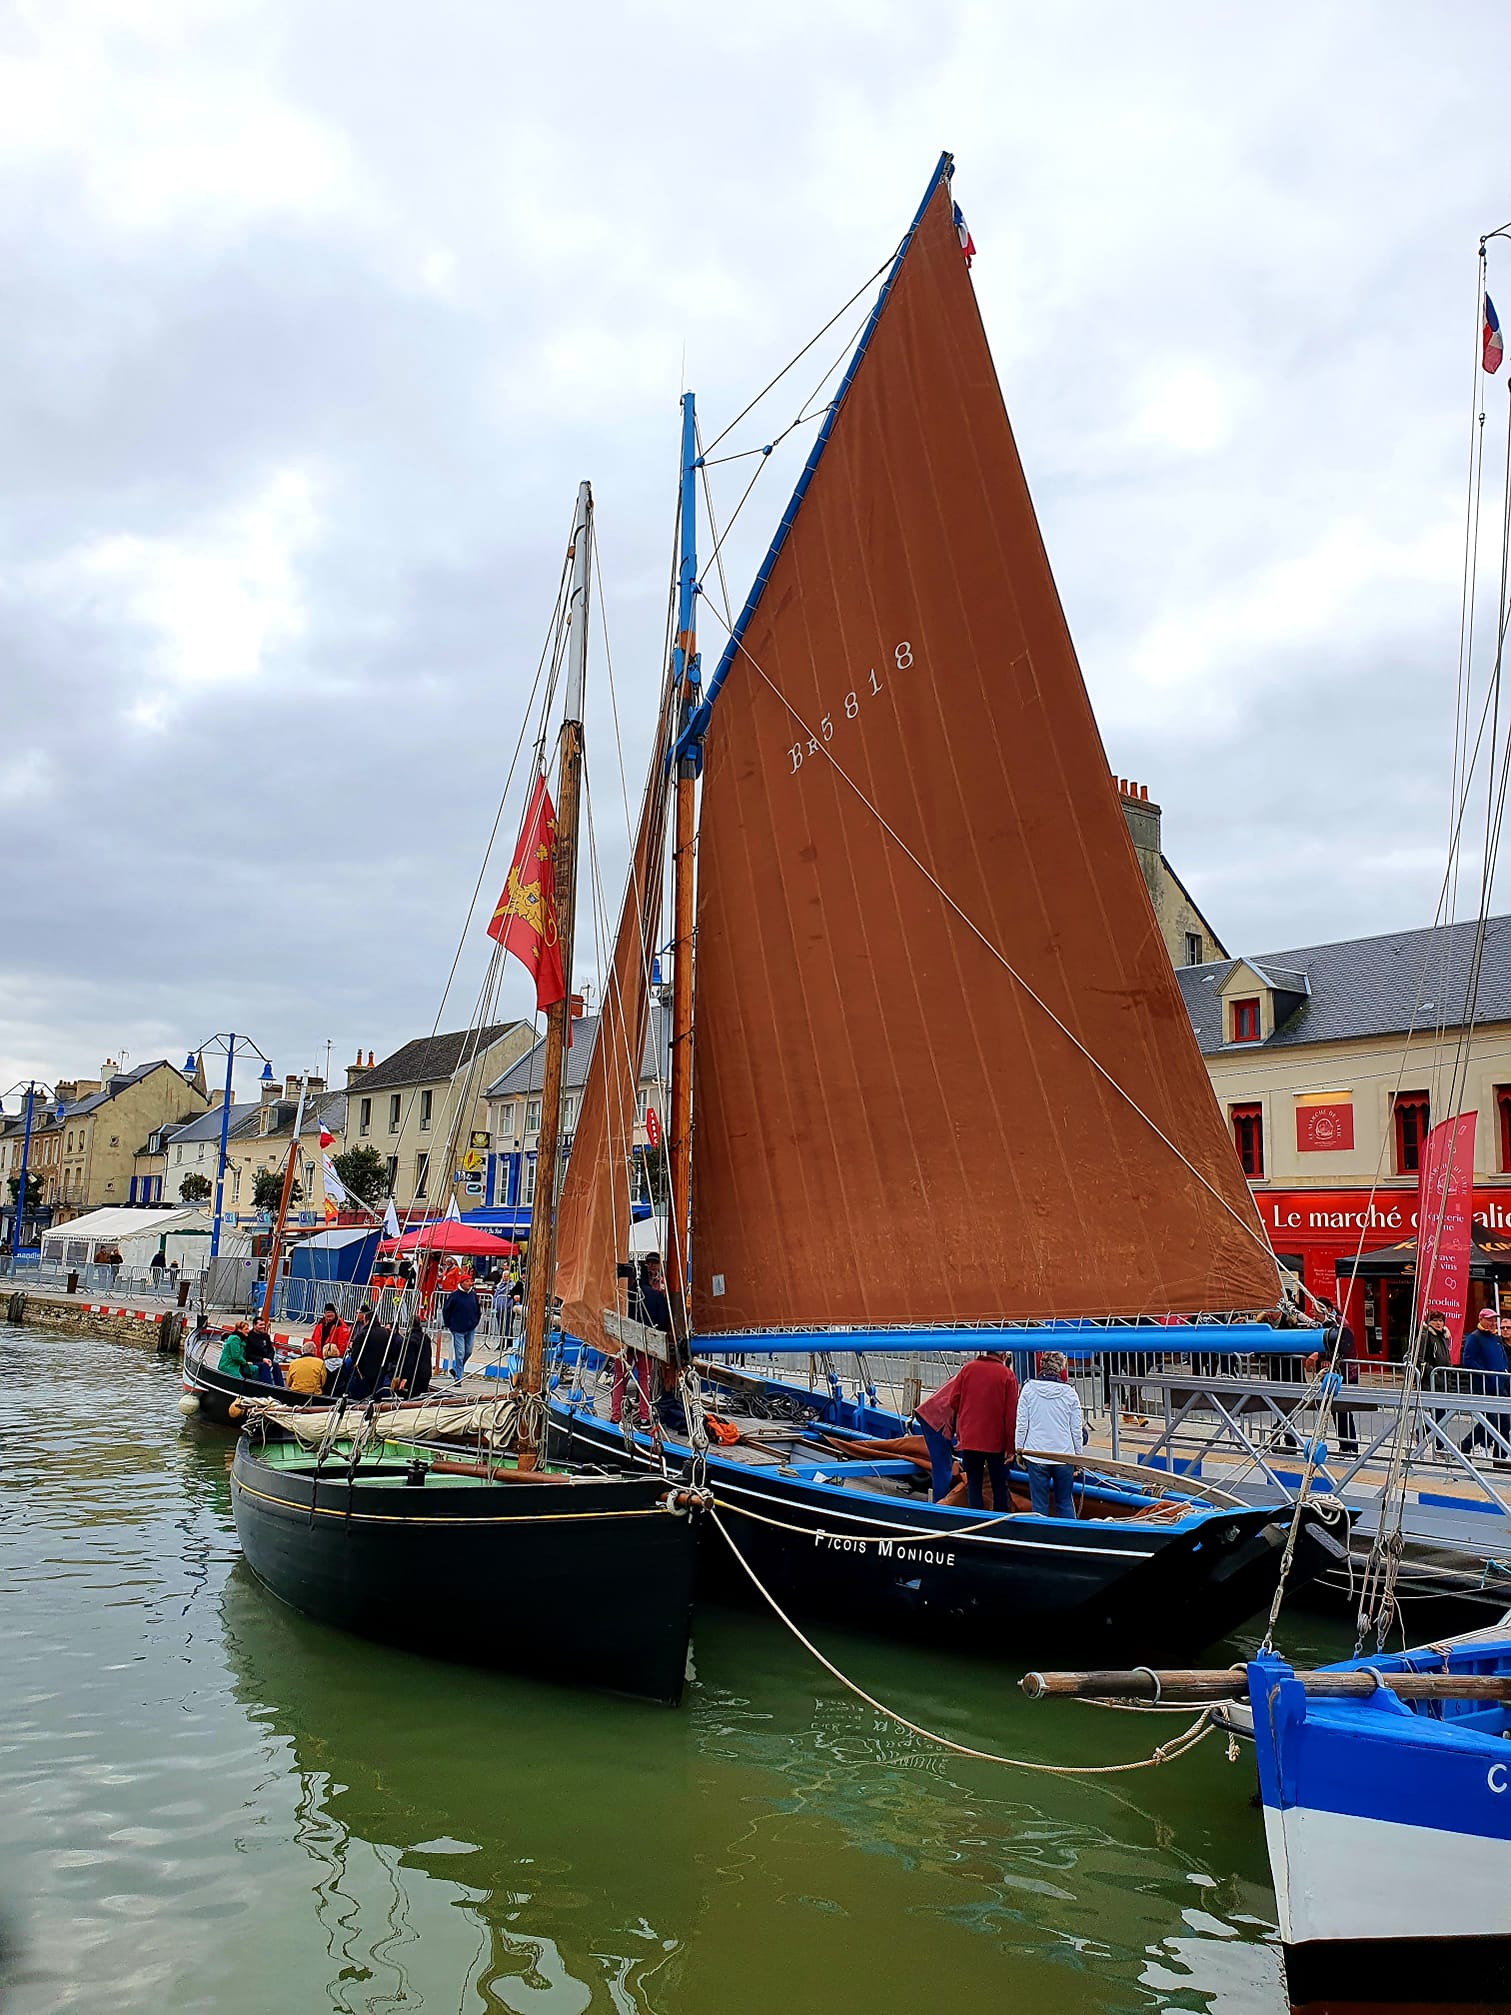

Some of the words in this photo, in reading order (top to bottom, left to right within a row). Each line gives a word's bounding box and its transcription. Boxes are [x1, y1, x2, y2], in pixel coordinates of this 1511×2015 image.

[650, 1112, 658, 1144] TABAC
[1273, 1205, 1301, 1228] Le
[1309, 1204, 1402, 1228] marché
[878, 1540, 956, 1566] MONIQUE
[1487, 1763, 1508, 1794] C
